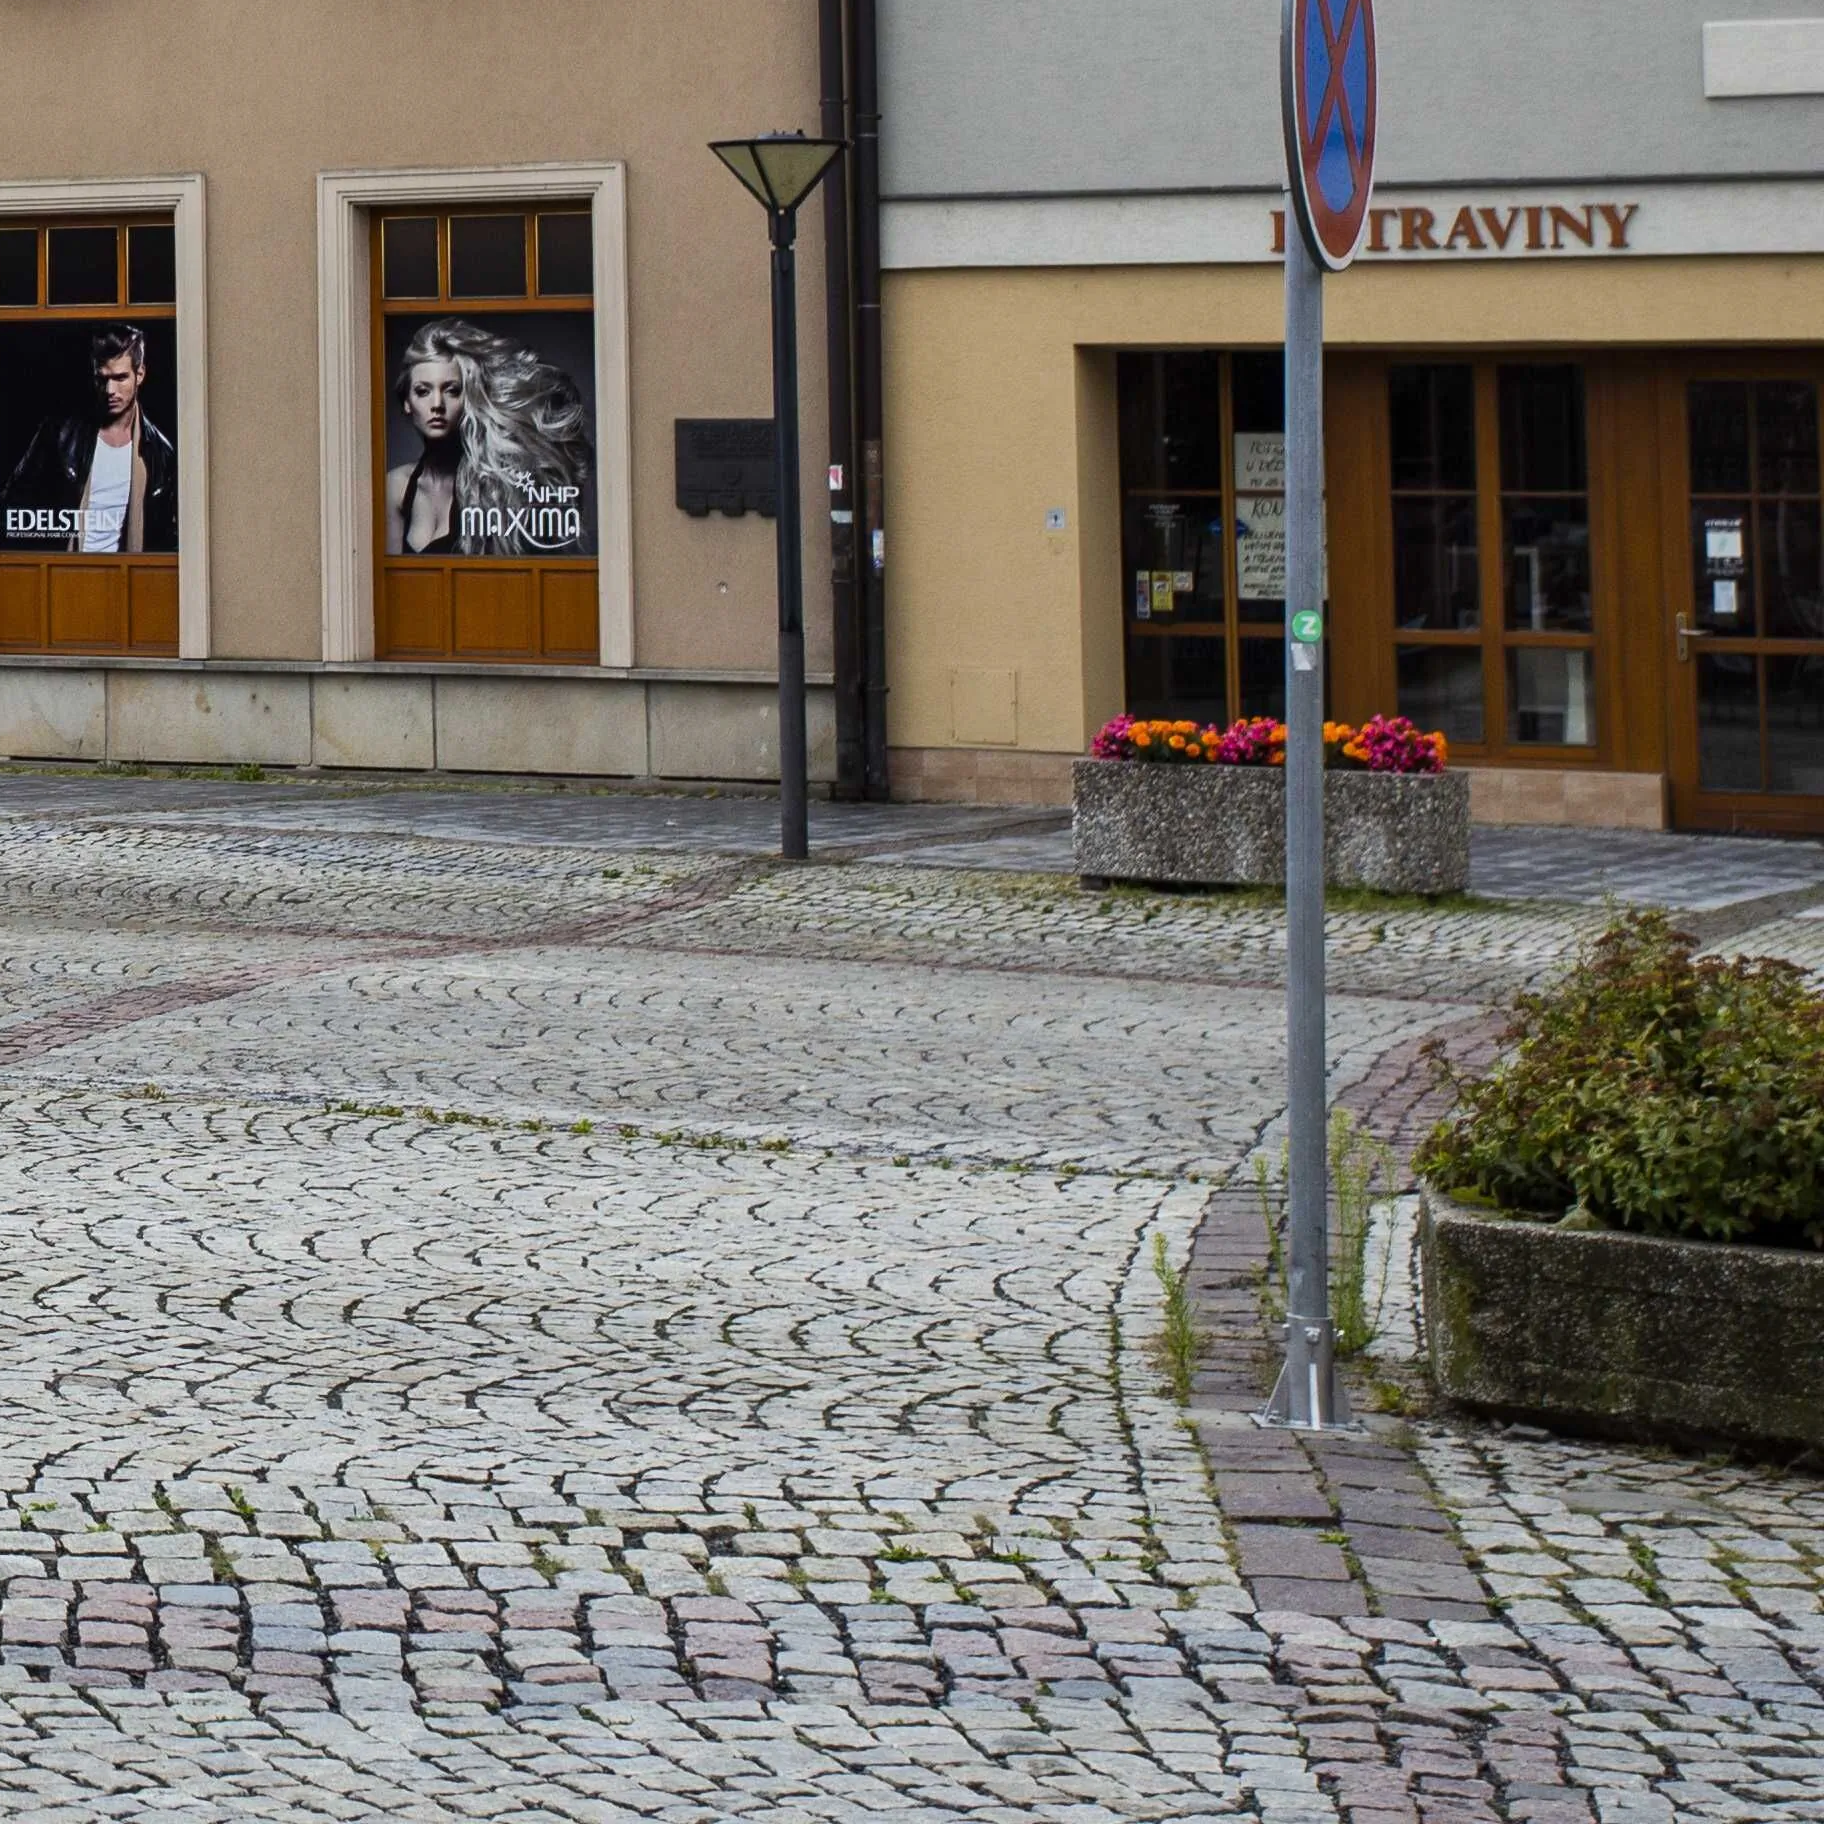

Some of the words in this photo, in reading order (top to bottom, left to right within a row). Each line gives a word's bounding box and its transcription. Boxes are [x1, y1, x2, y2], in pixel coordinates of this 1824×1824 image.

[1270, 204, 1640, 253] TRAVINY
[528, 486, 580, 503] NHP
[6, 509, 121, 531] EDELSTEIN
[461, 507, 580, 546] MAXIMA
[1300, 616, 1316, 635] Z
